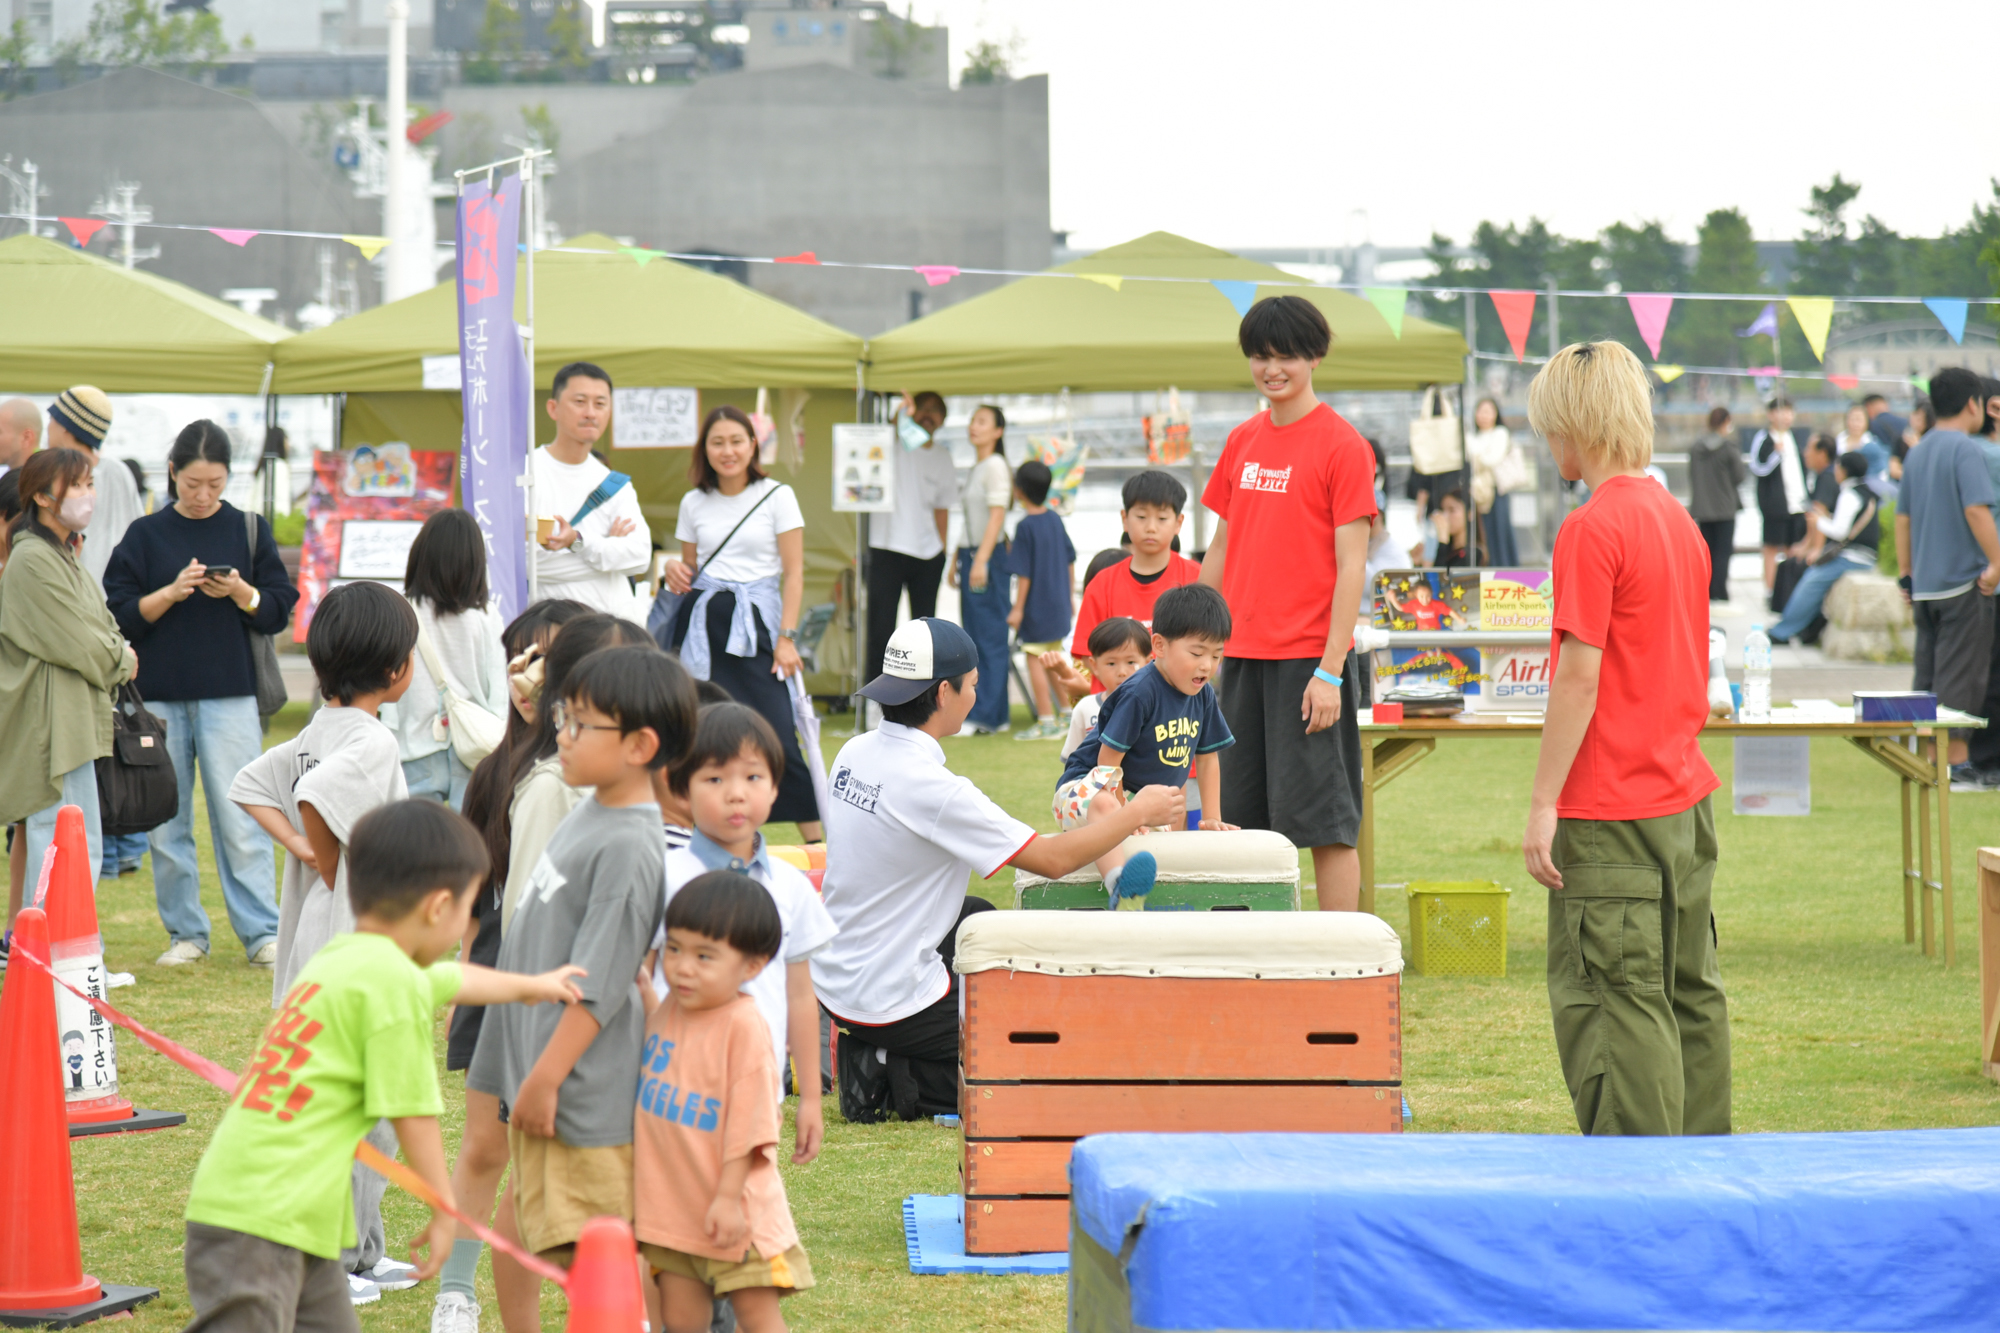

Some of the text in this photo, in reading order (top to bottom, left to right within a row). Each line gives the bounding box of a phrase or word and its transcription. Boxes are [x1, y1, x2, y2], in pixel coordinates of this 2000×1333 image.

[1258, 468, 1290, 480] GYMNASTICS
[1484, 602, 1516, 610] Airborn
[1519, 602, 1546, 611] Sports
[885, 646, 908, 660] VIREX
[849, 776, 881, 799] GYMNASTICS
[641, 1033, 676, 1075] OS
[635, 1073, 722, 1133] GELES
